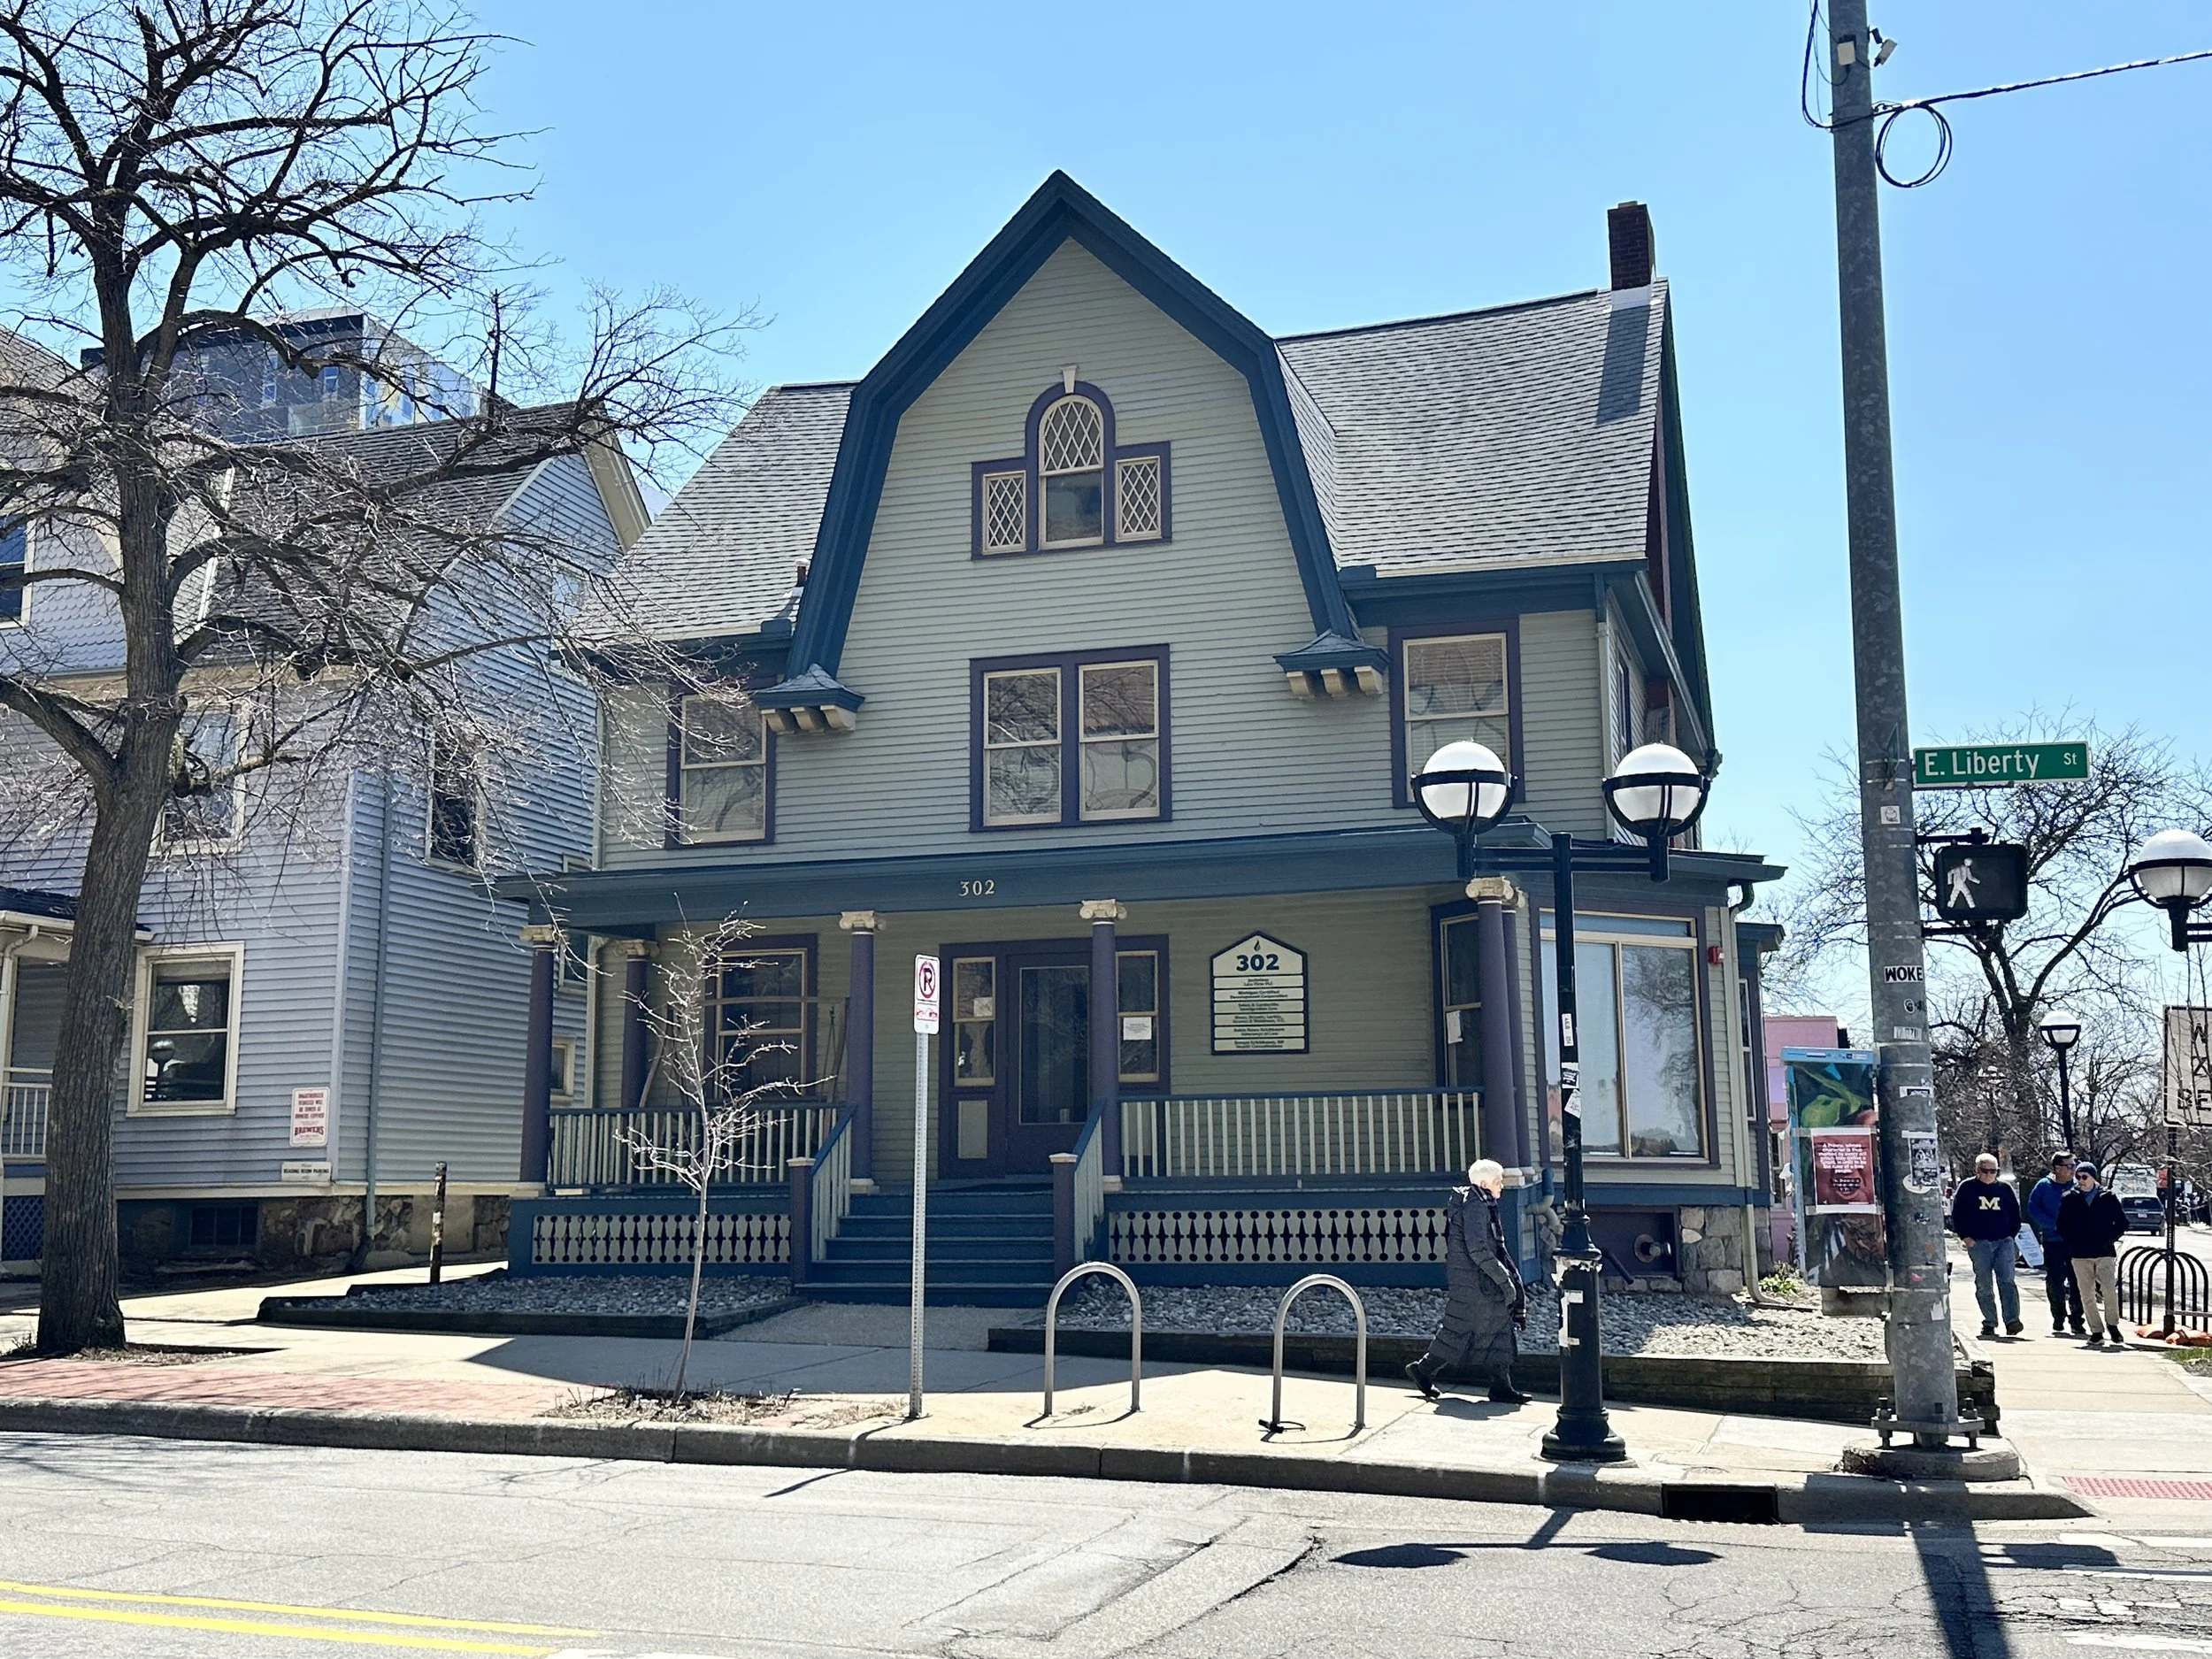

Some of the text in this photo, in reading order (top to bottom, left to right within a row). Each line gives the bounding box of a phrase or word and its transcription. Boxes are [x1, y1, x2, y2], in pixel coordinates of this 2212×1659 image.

[1924, 749, 2078, 779] E. Liberty St
[958, 879, 995, 896] 302
[1236, 954, 1279, 972] 302
[1885, 966, 1924, 982] WOKE
[1978, 1195, 2001, 1211] M
